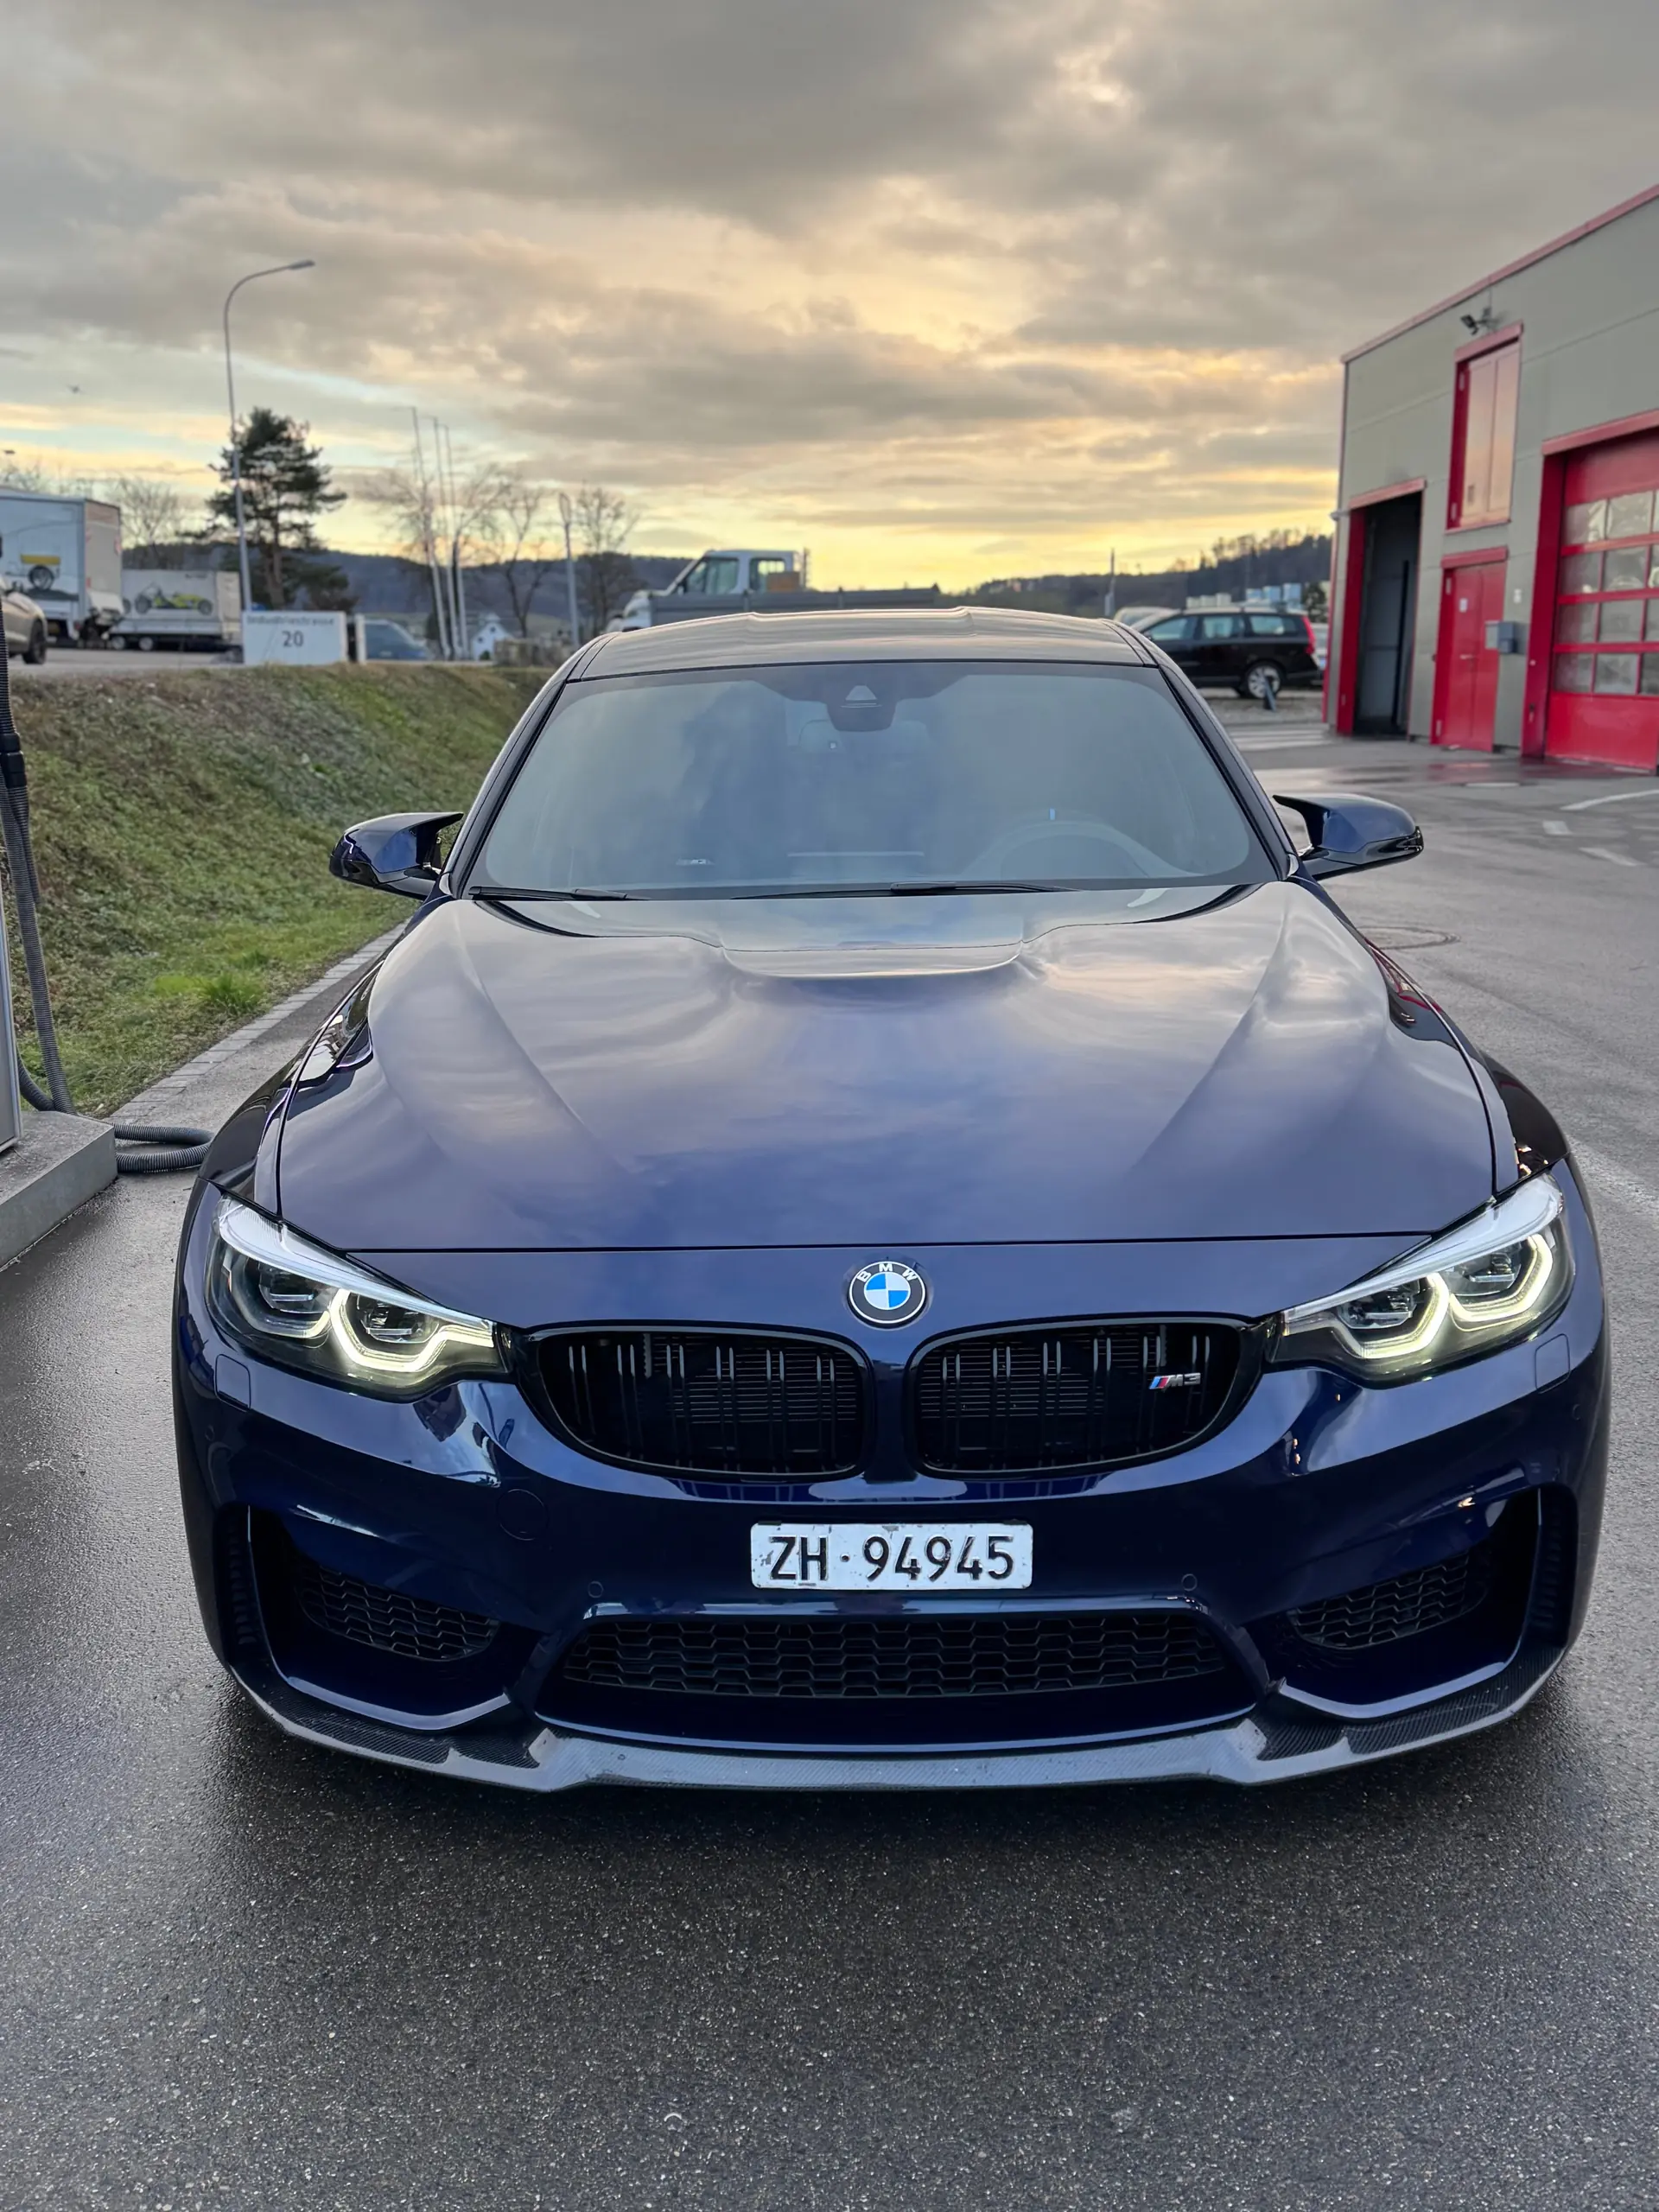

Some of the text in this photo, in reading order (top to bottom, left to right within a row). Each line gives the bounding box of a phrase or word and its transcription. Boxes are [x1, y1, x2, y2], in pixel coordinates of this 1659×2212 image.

[282, 630, 304, 648] 20
[856, 1263, 918, 1282] BMW
[1161, 1372, 1201, 1392] M3
[769, 1535, 1014, 1582] ZH 94945
